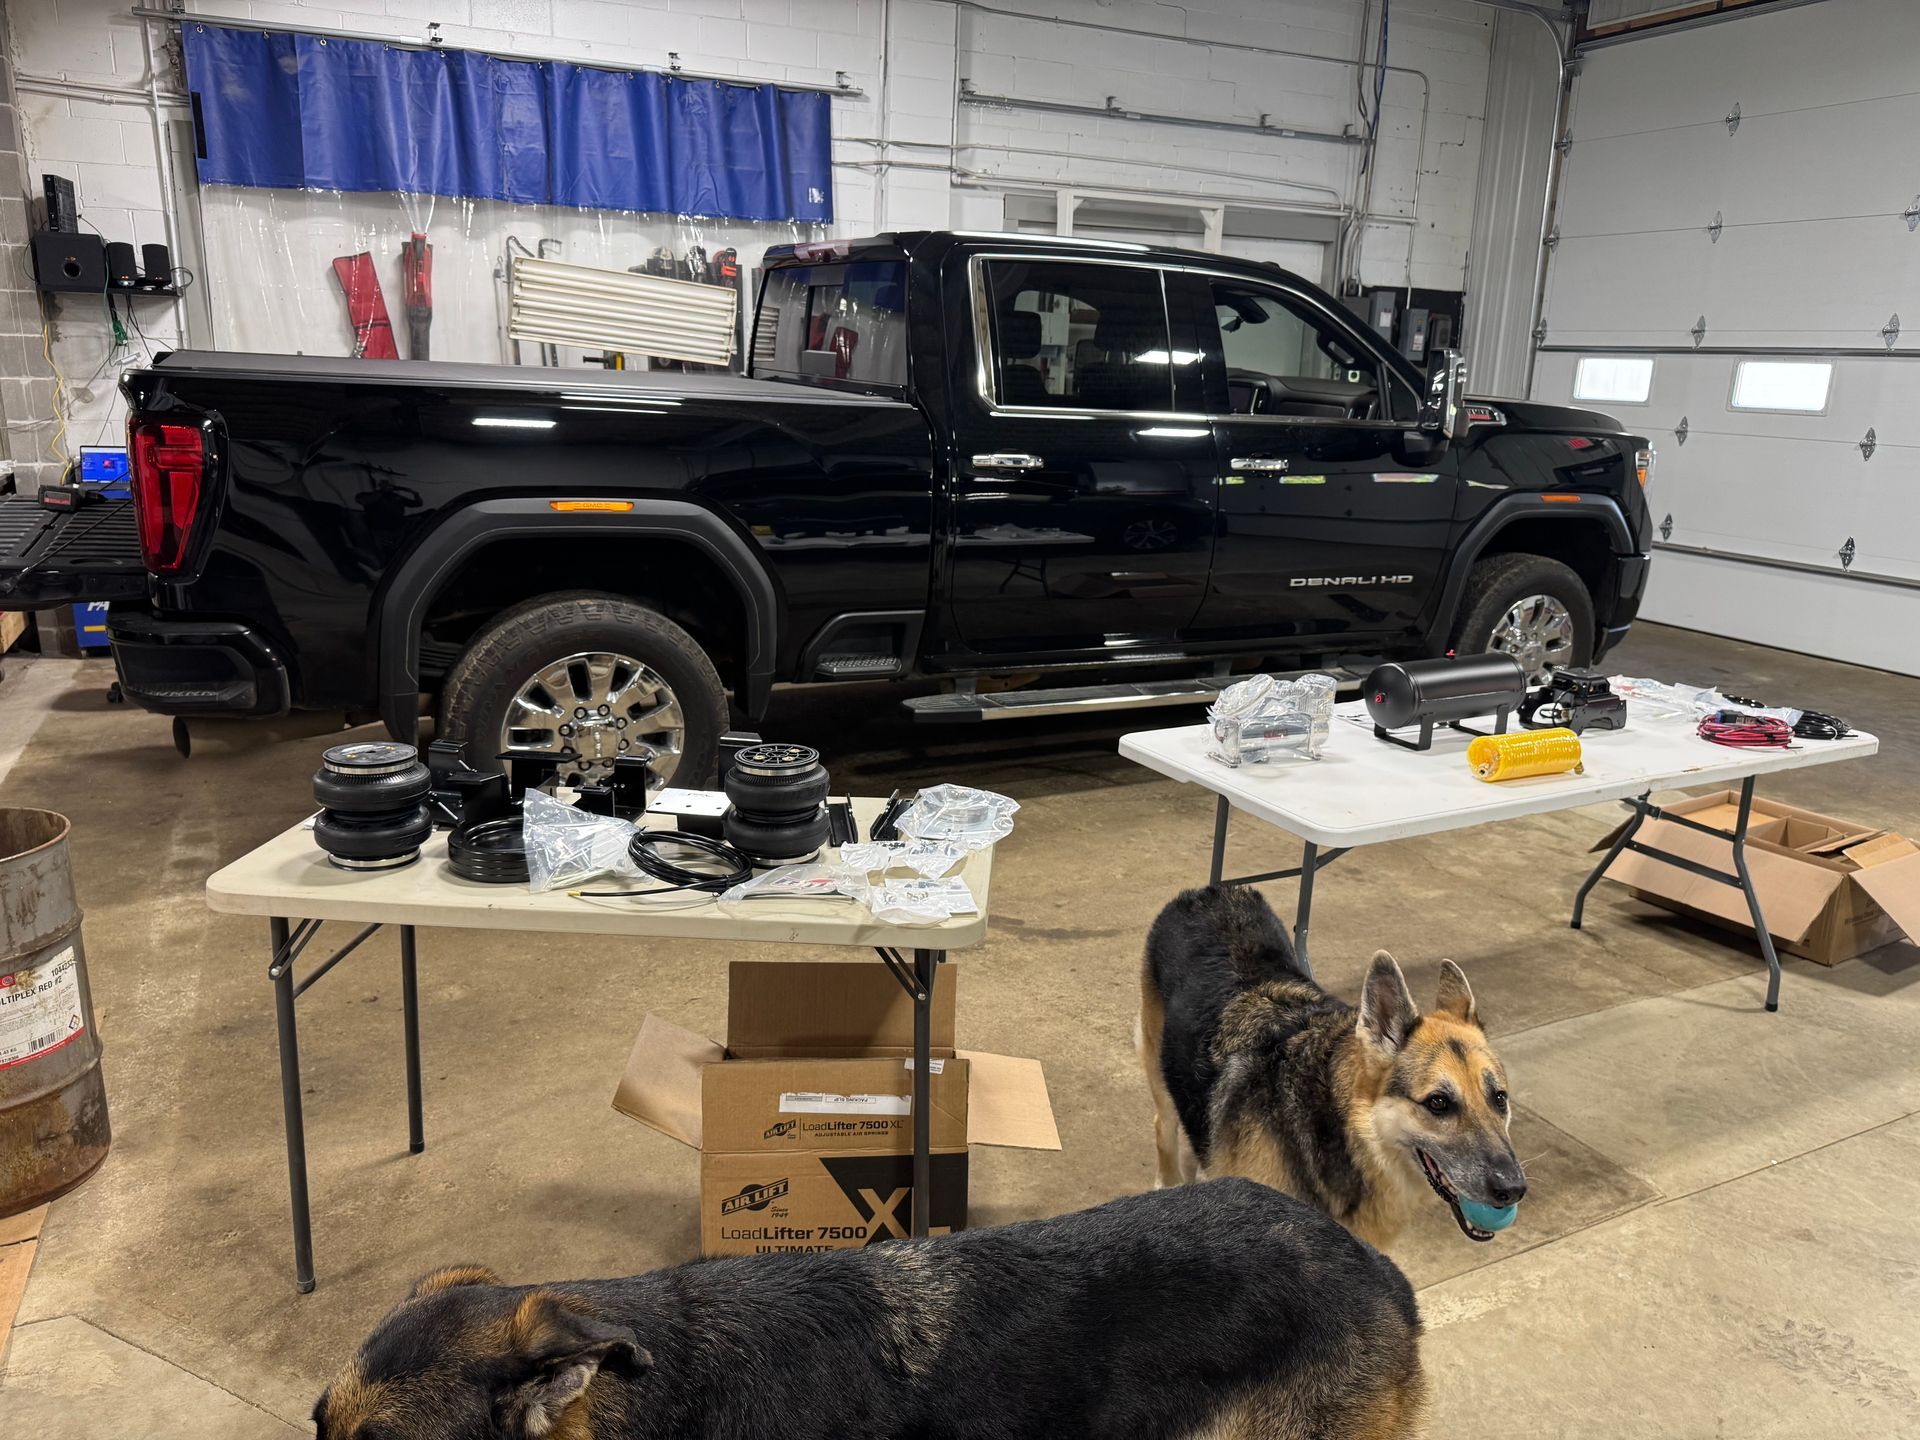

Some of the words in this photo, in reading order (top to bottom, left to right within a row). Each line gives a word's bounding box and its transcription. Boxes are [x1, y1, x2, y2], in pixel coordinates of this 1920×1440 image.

[1289, 576, 1377, 587] DENALI
[1380, 575, 1414, 584] HD
[0, 988, 37, 1006] LTIPLEX
[38, 980, 53, 993] RED
[802, 1121, 858, 1131] LoadLifter
[859, 1120, 889, 1130] 7500
[723, 1195, 752, 1212] AIR
[754, 1181, 787, 1202] LIFT
[721, 1226, 814, 1240] LoadLifter
[817, 1226, 868, 1240] 7500
